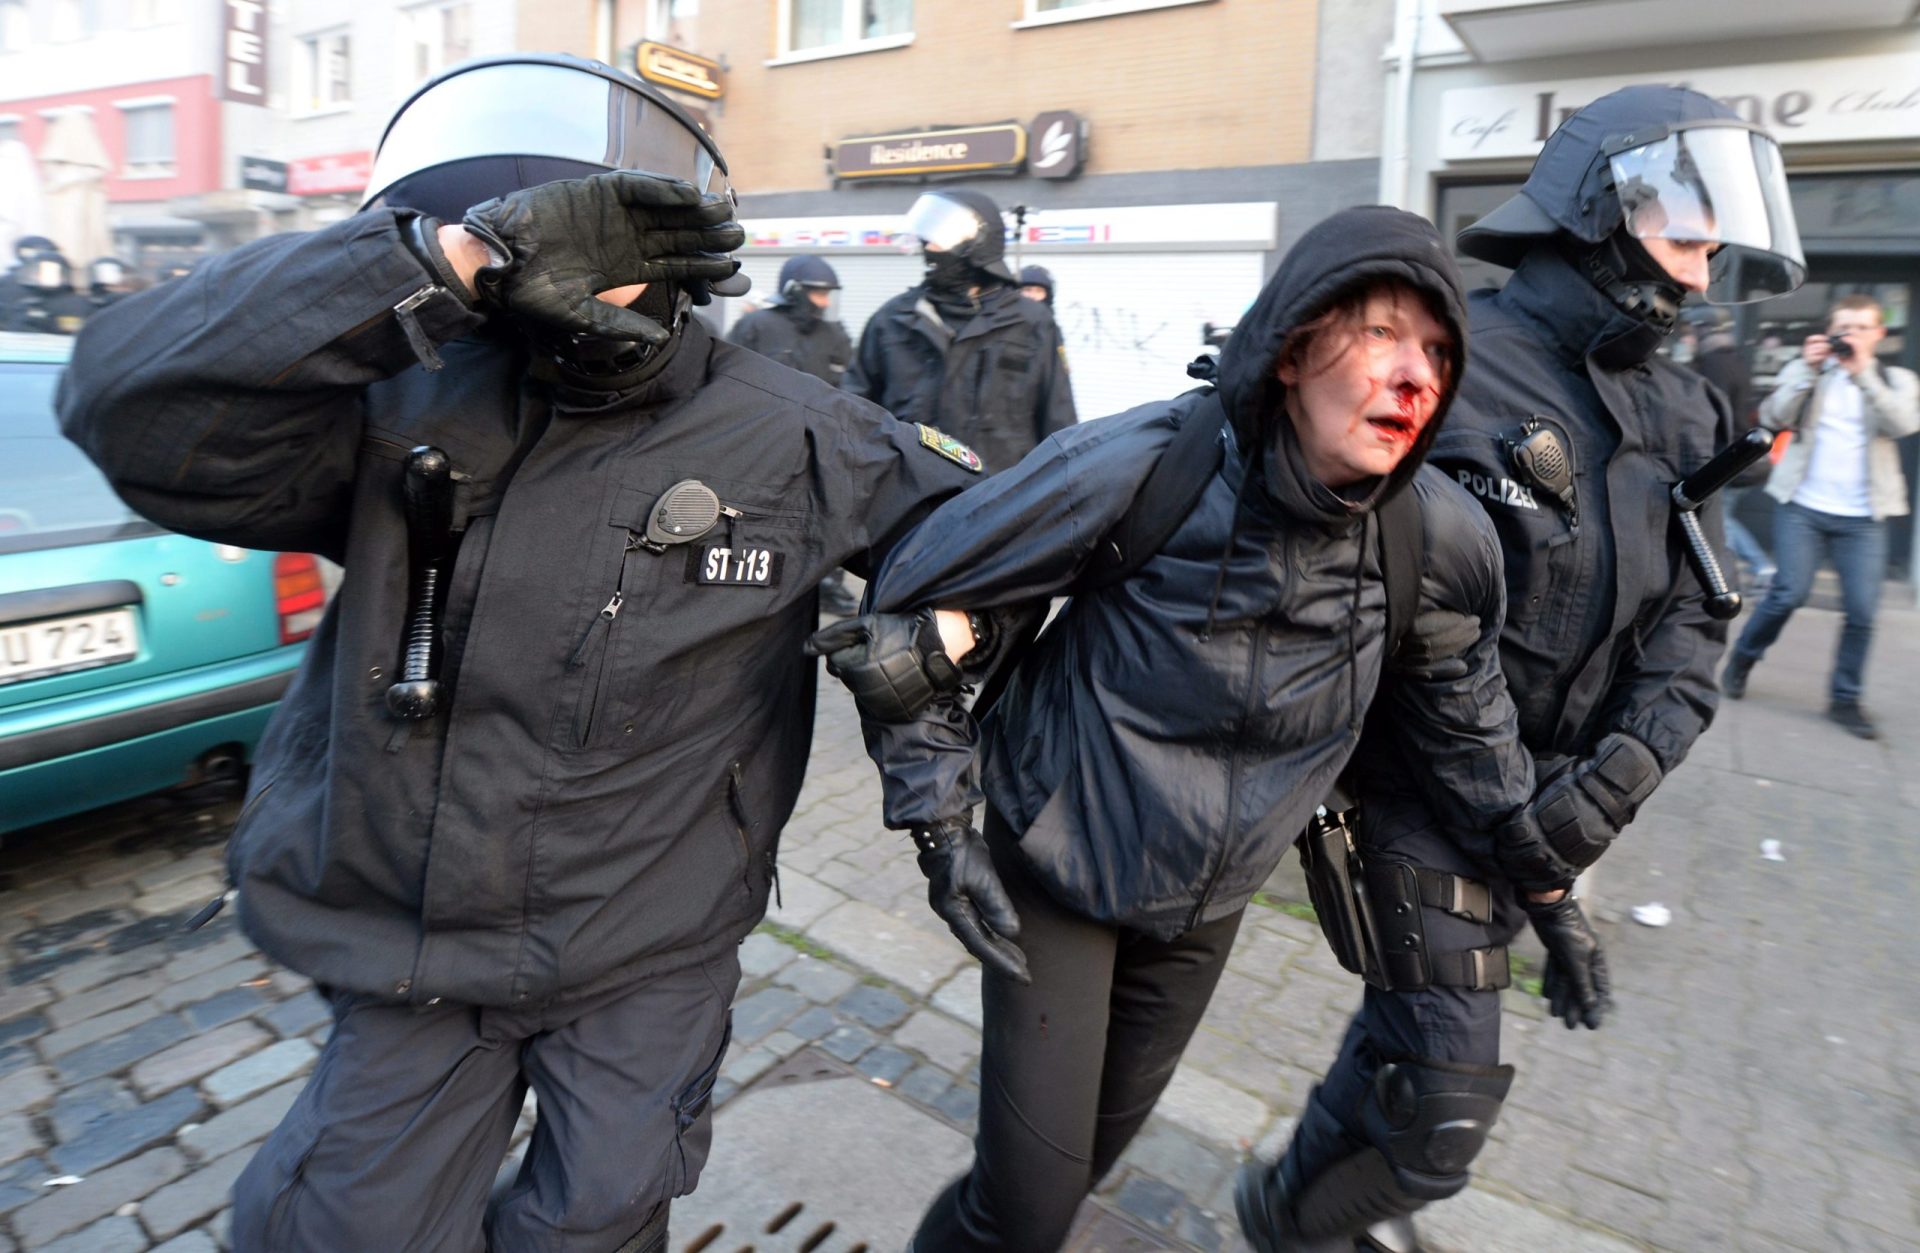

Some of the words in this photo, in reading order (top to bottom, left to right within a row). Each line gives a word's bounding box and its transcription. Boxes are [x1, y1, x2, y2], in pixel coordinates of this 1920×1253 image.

[870, 140, 969, 165] Residence
[1457, 468, 1539, 510] POLIZEI
[705, 547, 732, 581] ST
[46, 617, 127, 660] 724
